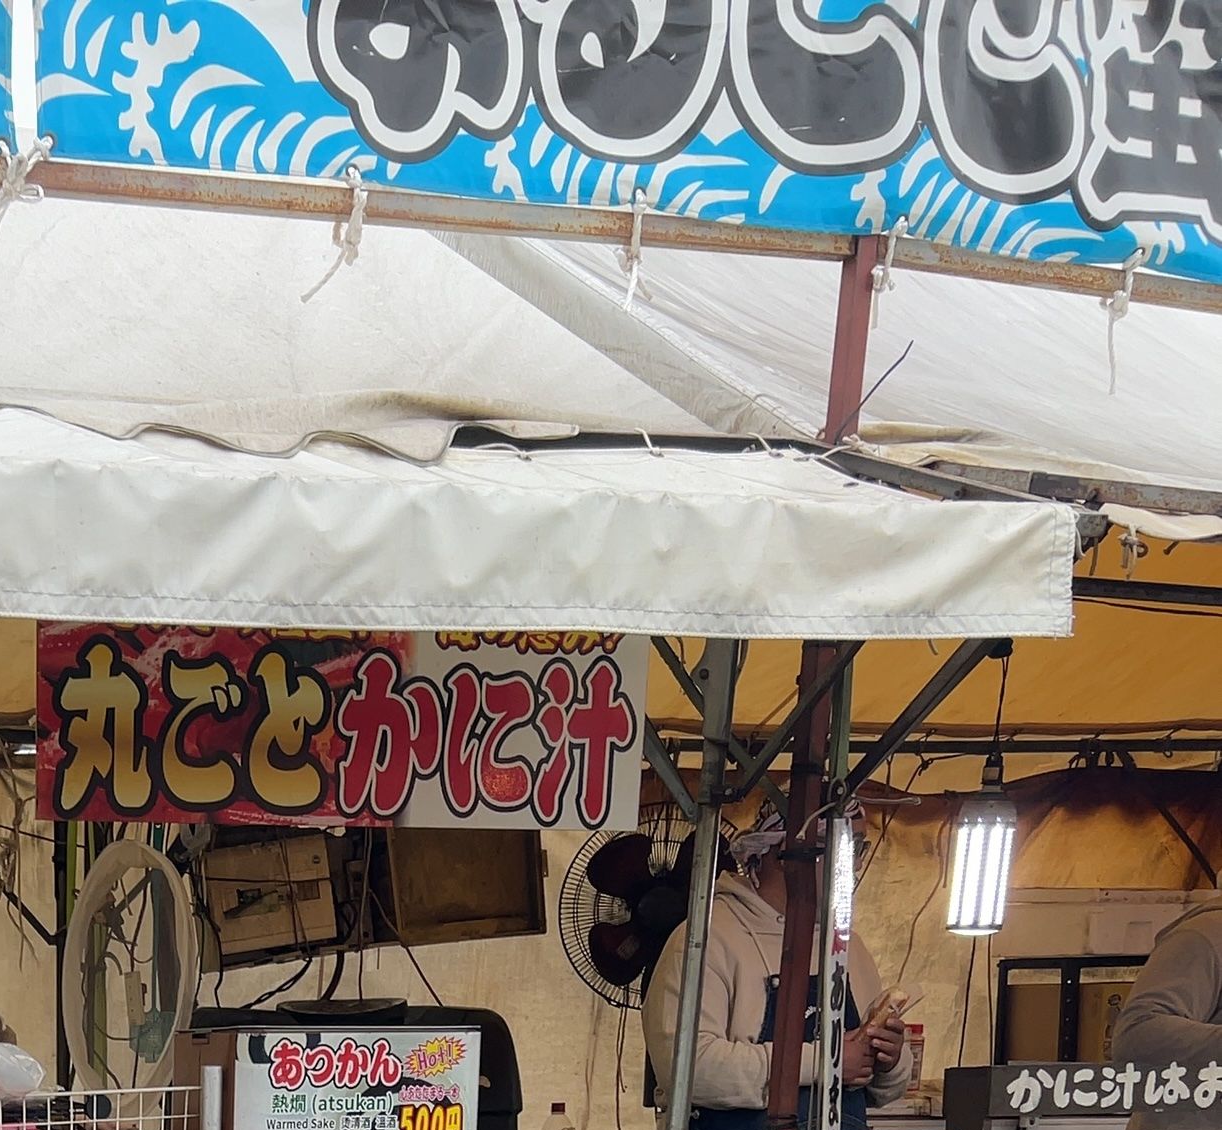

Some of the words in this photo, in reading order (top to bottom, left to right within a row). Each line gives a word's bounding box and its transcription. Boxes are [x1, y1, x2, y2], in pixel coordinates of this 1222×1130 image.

[56, 636, 636, 828] 丸ごとかに汁
[269, 1037, 403, 1091] あつかん
[416, 1042, 455, 1067] Hot!
[312, 1092, 393, 1115] (atsukan)
[266, 1118, 308, 1130] Warmed
[311, 1118, 335, 1129] Sake
